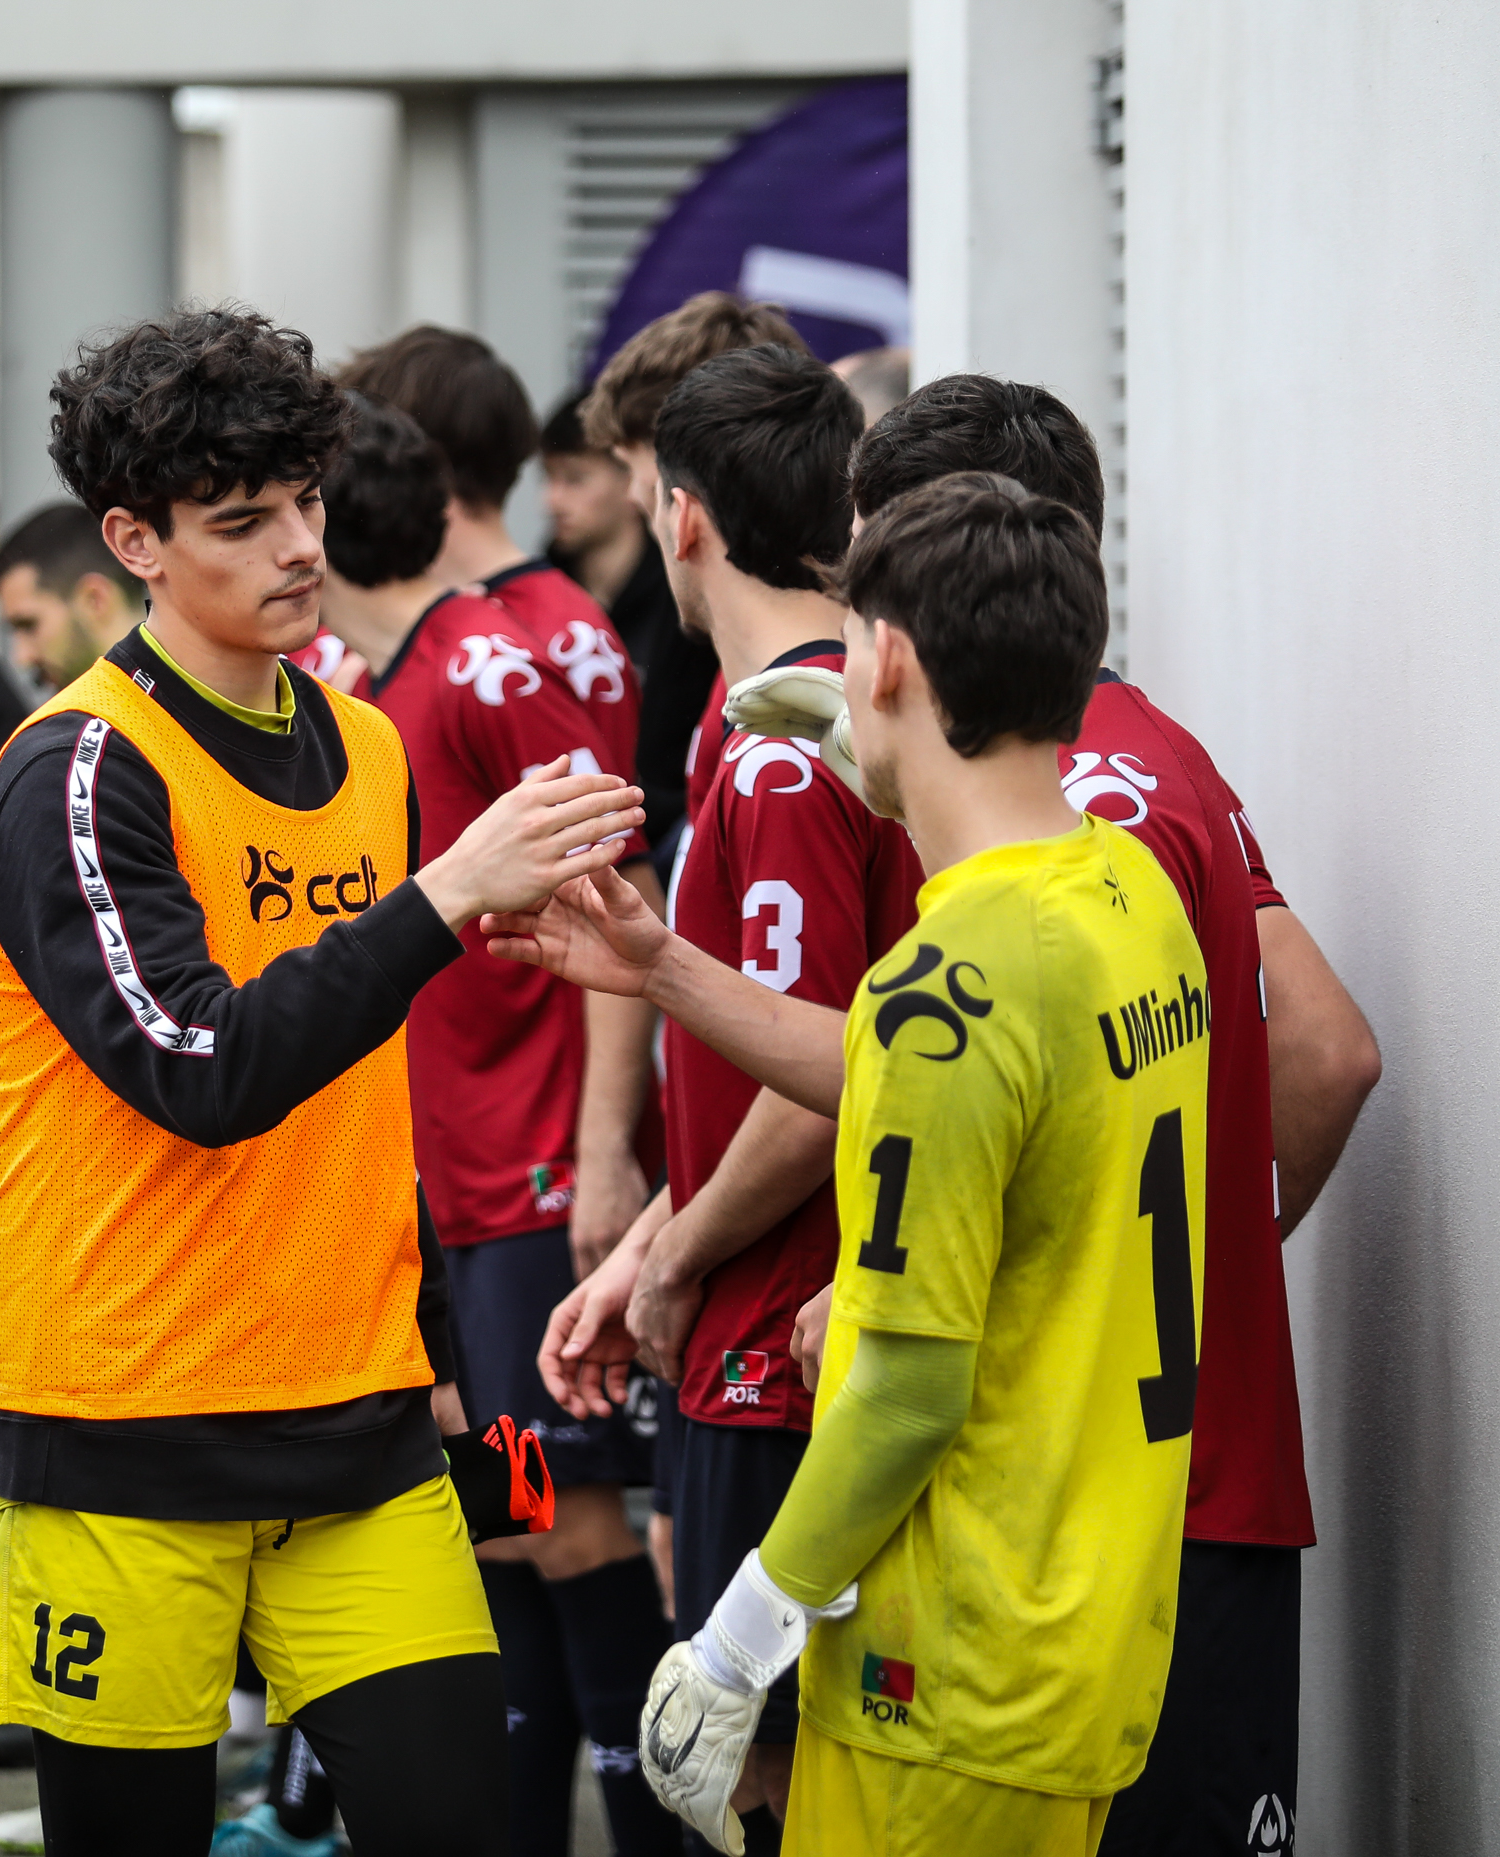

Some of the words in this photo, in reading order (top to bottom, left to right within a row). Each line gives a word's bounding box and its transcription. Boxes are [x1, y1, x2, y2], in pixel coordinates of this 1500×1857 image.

[76, 735, 100, 766] NIKE
[72, 803, 93, 839] NIKE
[84, 882, 116, 913] NIKE
[741, 880, 804, 993] 3
[108, 950, 134, 976] NIKE
[857, 1133, 914, 1276] 1
[1137, 1106, 1200, 1444] 1
[722, 1385, 761, 1405] POR
[30, 1602, 107, 1701] 12
[862, 1695, 909, 1726] POR
